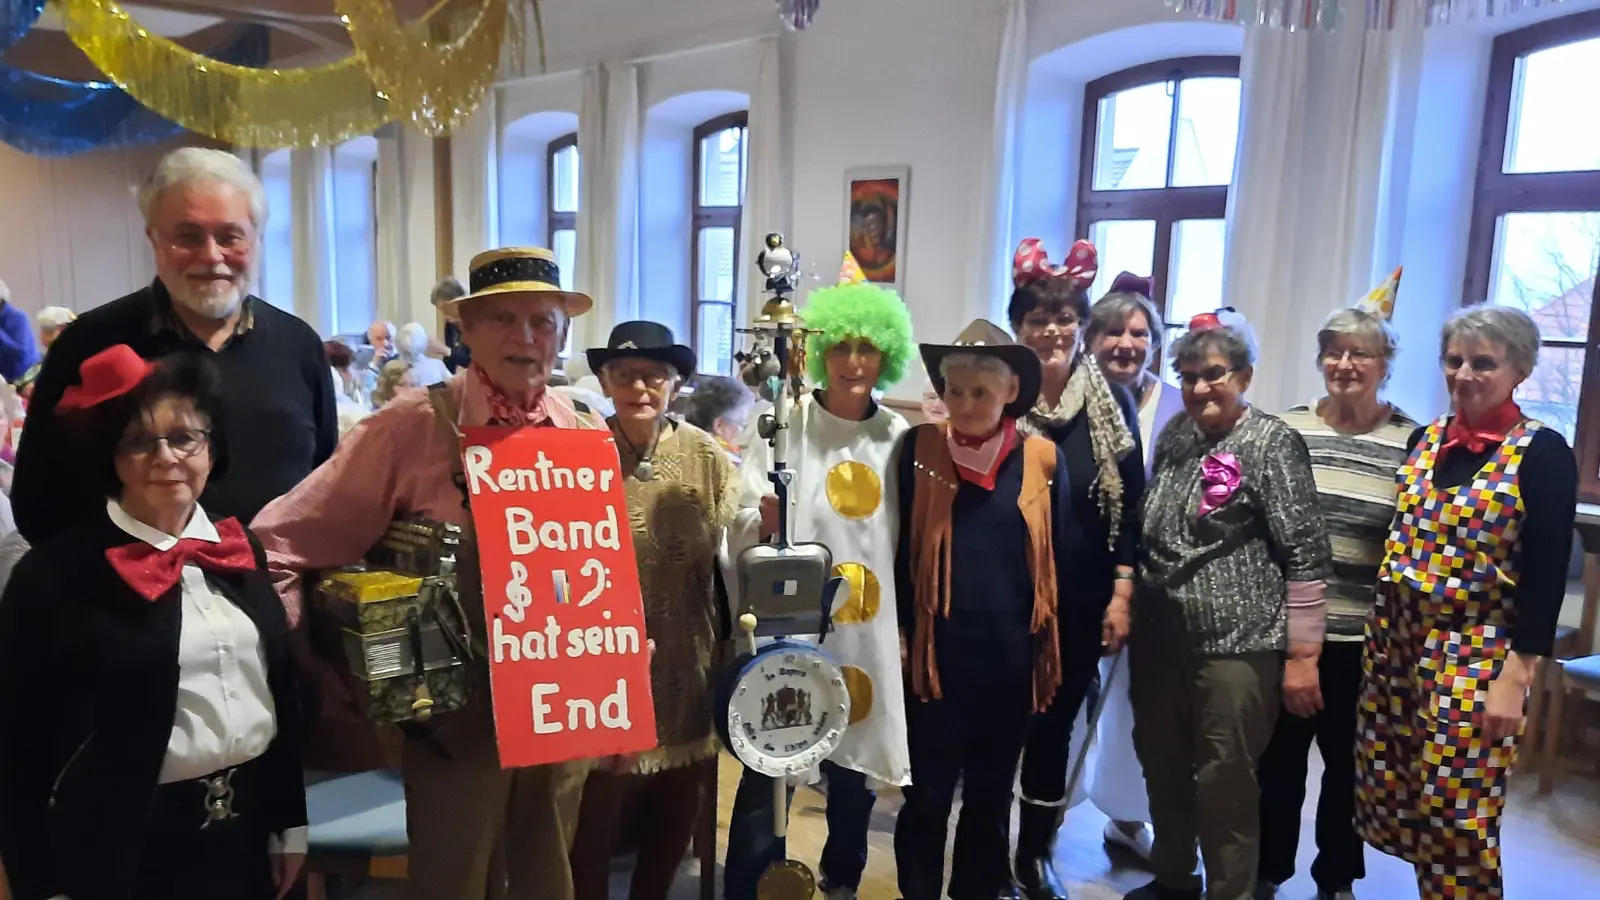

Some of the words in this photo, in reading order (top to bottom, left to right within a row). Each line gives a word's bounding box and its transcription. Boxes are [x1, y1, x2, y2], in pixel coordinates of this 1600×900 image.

[465, 445, 614, 494] Rentner
[505, 505, 621, 555] Band
[492, 616, 562, 663] hat
[565, 610, 640, 659] sein
[531, 678, 632, 734] End
